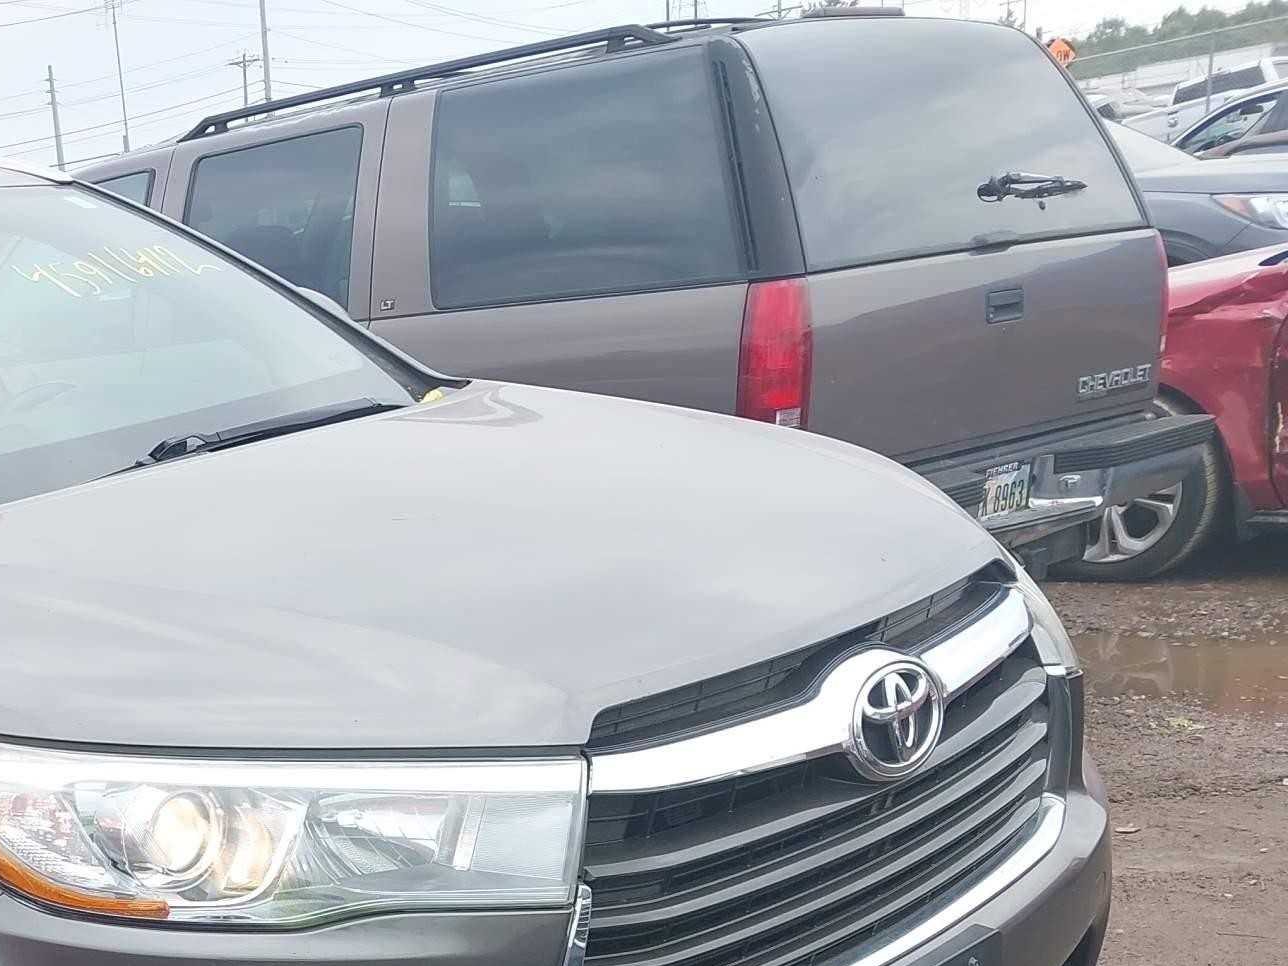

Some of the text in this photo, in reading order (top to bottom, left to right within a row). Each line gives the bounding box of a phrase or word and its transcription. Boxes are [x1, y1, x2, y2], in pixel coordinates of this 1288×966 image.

[381, 300, 394, 310] LT
[1078, 363, 1152, 394] CHEVROLET
[993, 479, 1025, 513] 8963
